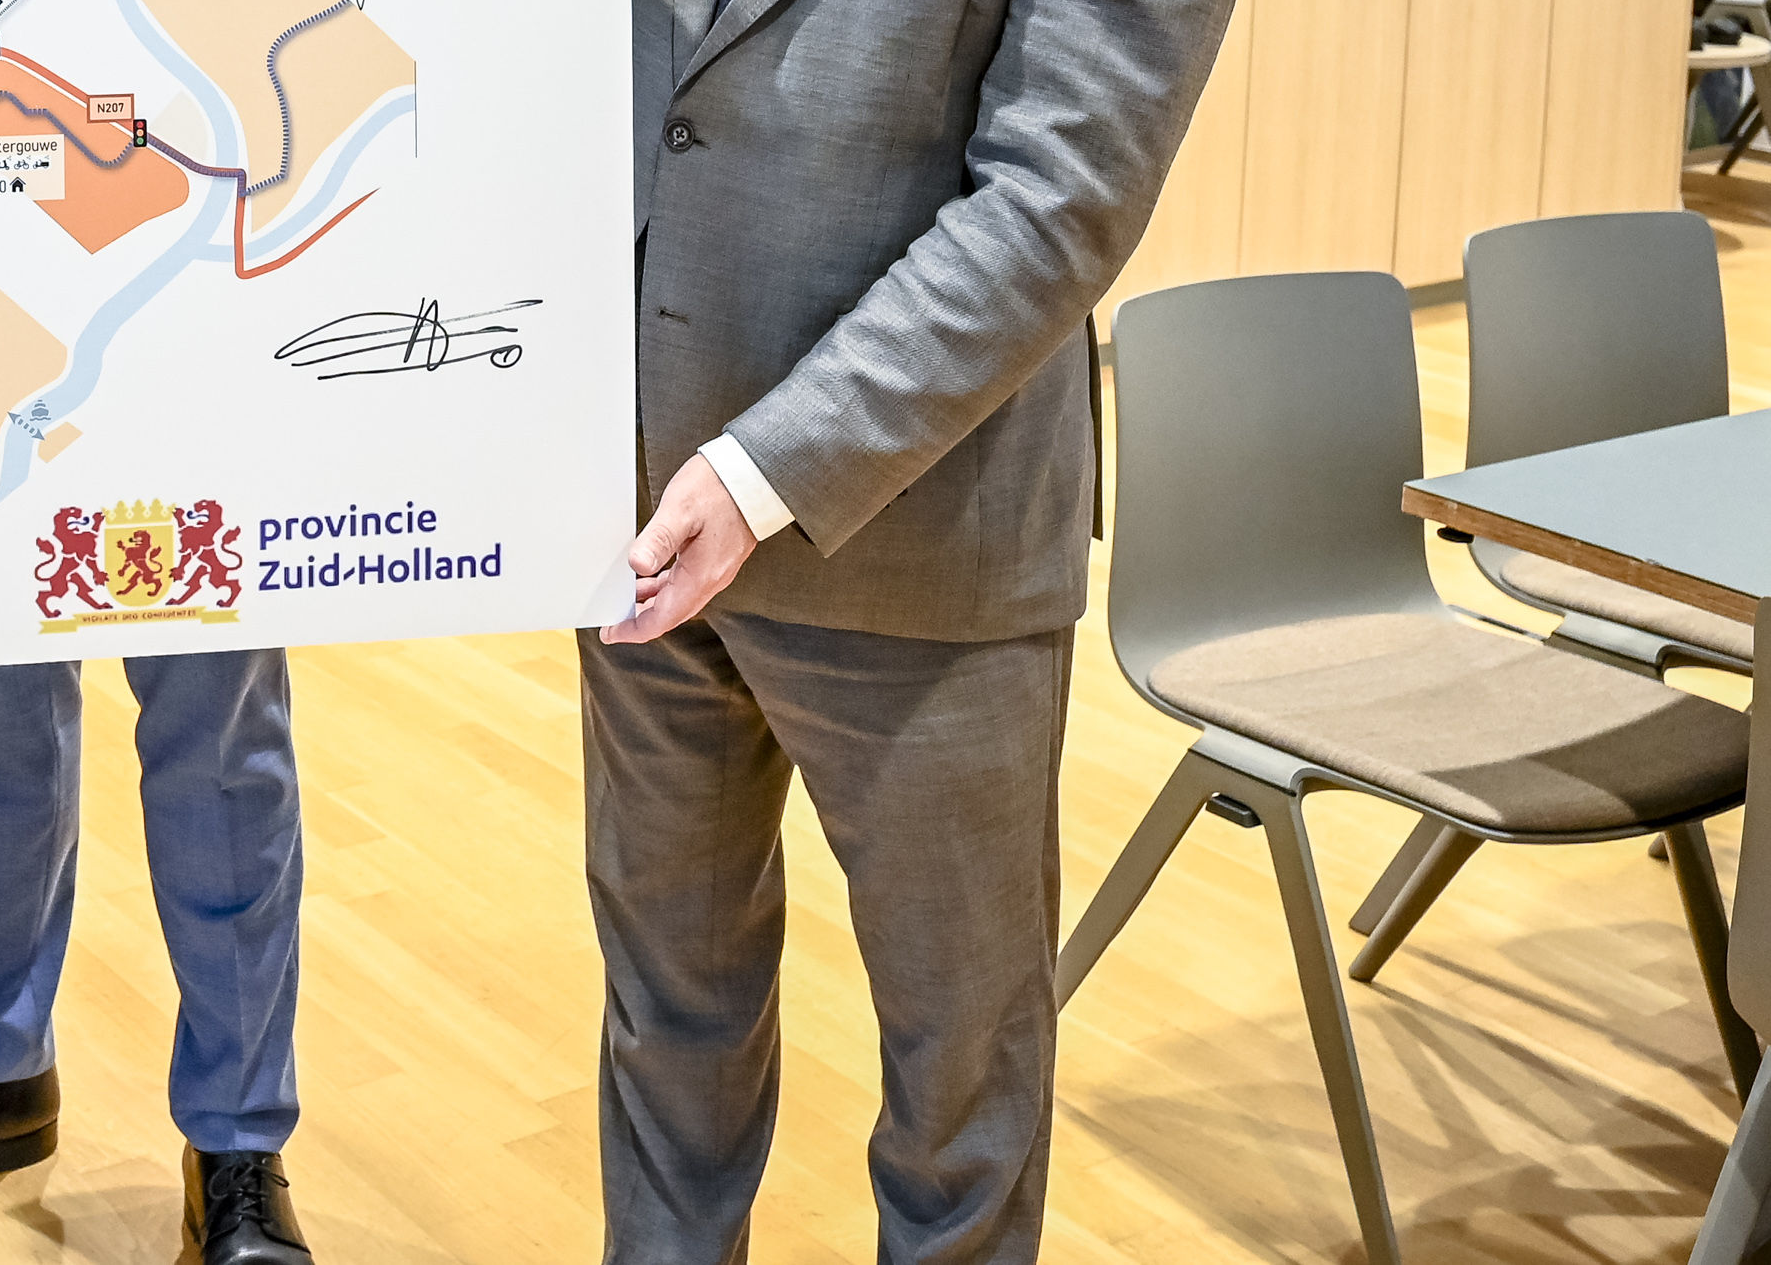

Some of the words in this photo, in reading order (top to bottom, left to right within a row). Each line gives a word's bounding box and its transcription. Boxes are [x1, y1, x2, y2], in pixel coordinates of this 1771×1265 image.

[96, 101, 124, 114] N207
[258, 501, 438, 550] provincie
[257, 543, 503, 591] Zuid-Holland
